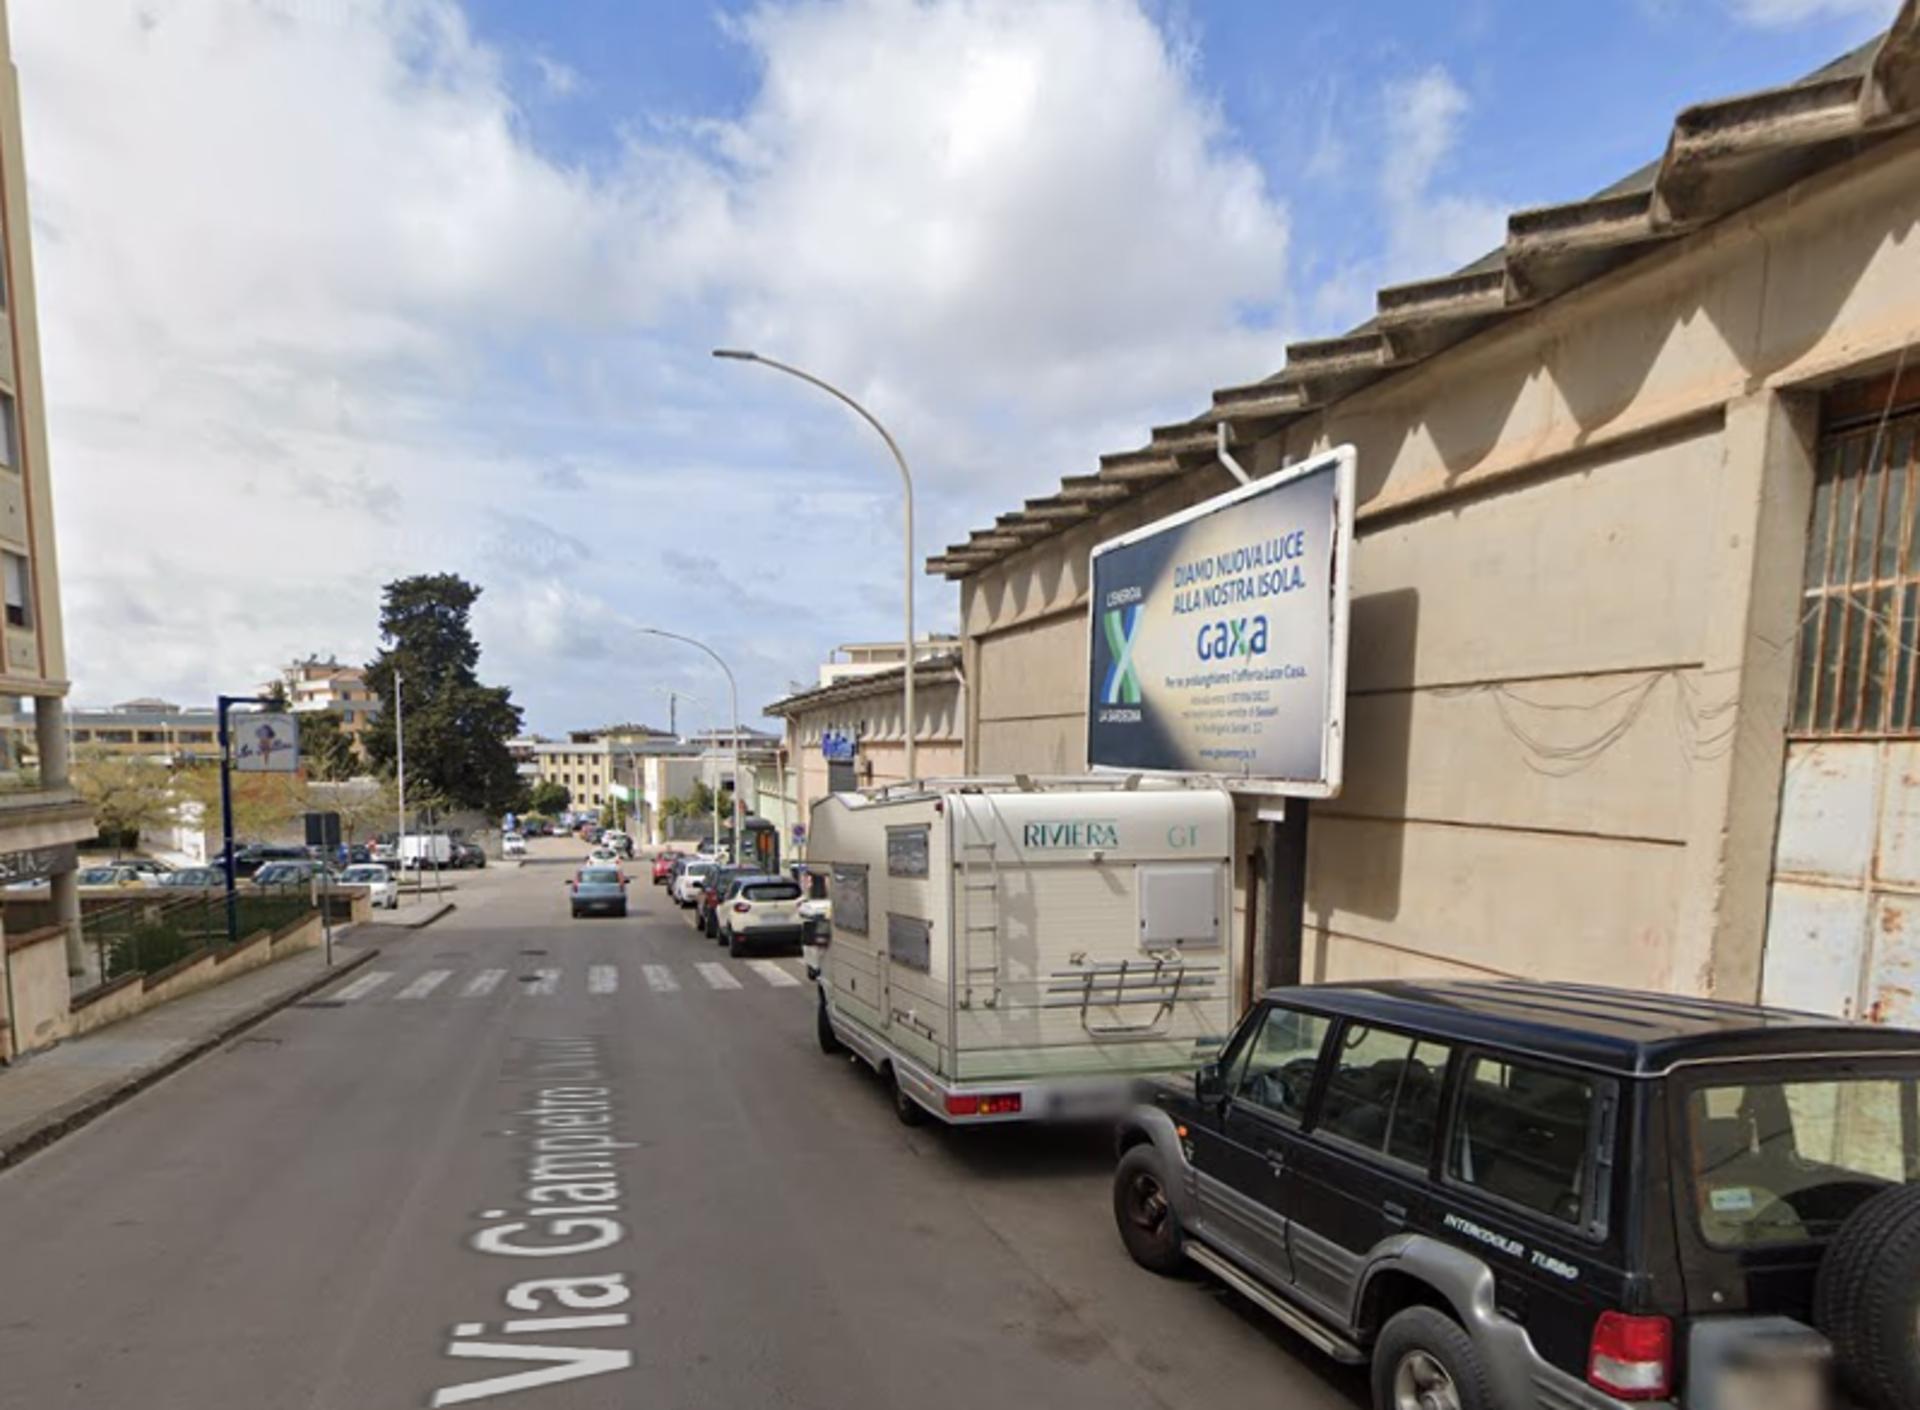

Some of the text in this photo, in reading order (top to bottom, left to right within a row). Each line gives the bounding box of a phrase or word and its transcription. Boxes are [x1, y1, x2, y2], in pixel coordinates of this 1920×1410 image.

[1174, 530, 1304, 588] DIAMO NUOVA LUCE
[1173, 588, 1200, 615] ALLA
[1204, 577, 1254, 608] NOSTRA
[1024, 823, 1199, 848] RIVIERA GT
[1443, 1213, 1579, 1279] INTERCOOLER TURBO
